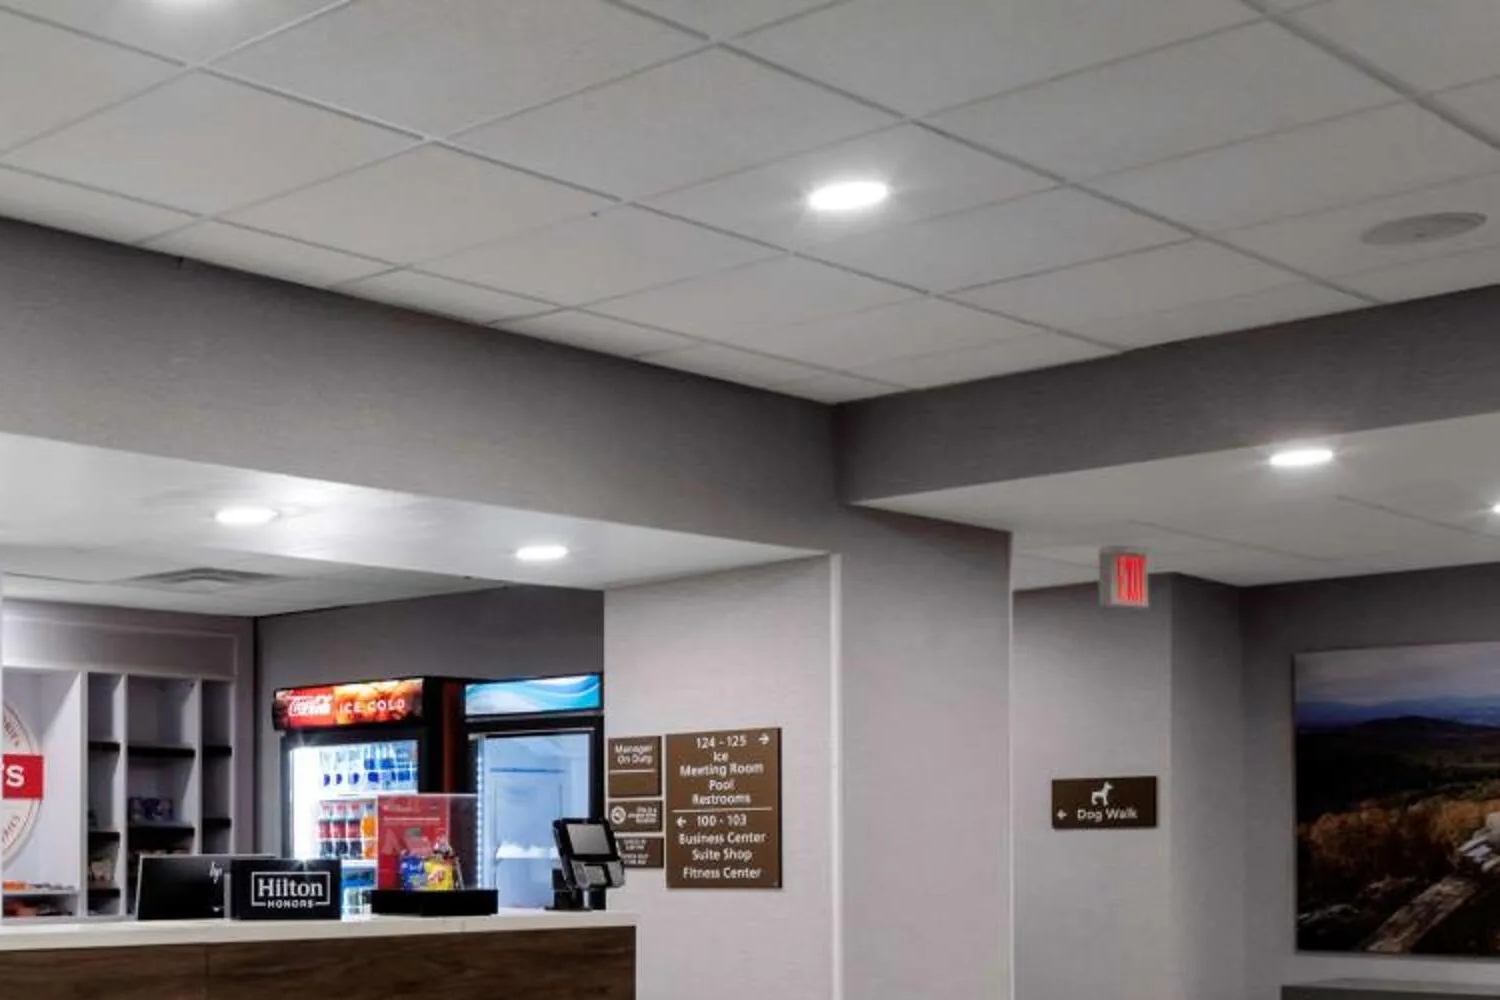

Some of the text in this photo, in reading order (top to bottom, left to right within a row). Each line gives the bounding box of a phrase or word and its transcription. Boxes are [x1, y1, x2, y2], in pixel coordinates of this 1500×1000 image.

[340, 703, 362, 714] ICE
[368, 699, 406, 712] COLD
[697, 736, 716, 749] 124
[727, 735, 747, 747] 125
[713, 751, 730, 762] Ice
[680, 763, 764, 778] Meeting Room
[709, 779, 735, 790] Pool
[692, 793, 752, 805] Restrooms
[697, 815, 717, 827] 100
[727, 814, 747, 826] 103
[1077, 807, 1138, 822] Dog Walk
[679, 831, 766, 845] Business Center
[692, 847, 753, 862] Suite Shop
[683, 867, 762, 878] Fitness Center
[257, 877, 324, 898] Hilton
[267, 899, 315, 909] HONORS
